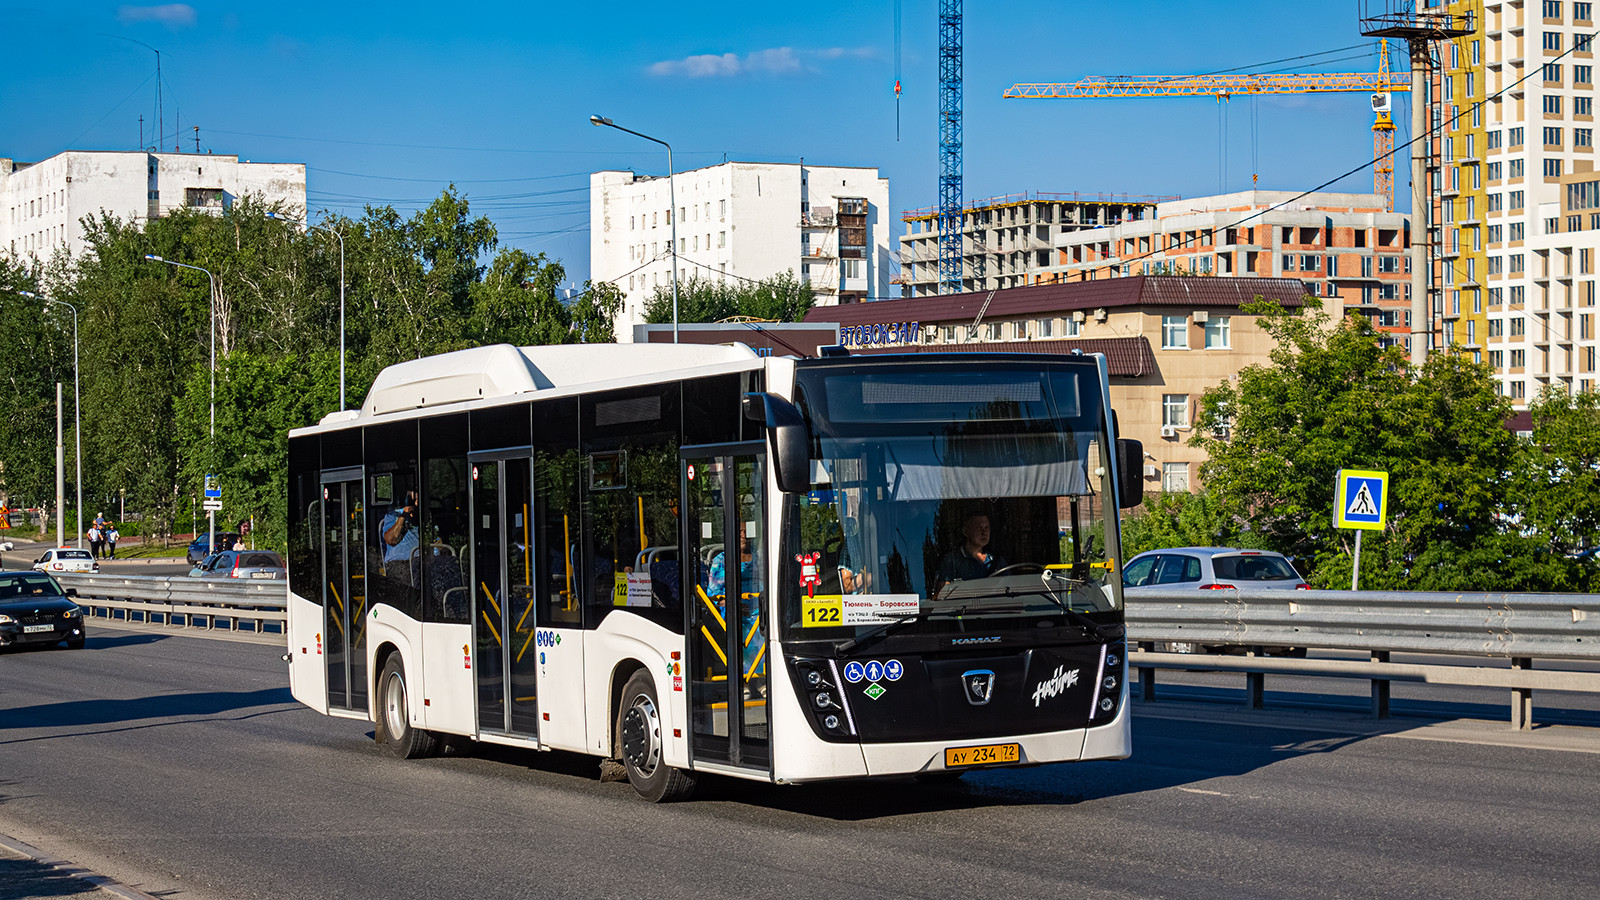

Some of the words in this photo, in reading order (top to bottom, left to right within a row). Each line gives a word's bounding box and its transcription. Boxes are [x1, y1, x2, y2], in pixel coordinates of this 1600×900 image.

[617, 583, 627, 596] 122
[880, 600, 918, 608] Боровский
[808, 607, 840, 622] 122
[951, 636, 1002, 645] KAMAZ
[973, 748, 996, 762] 234
[1003, 746, 1014, 756] 72
